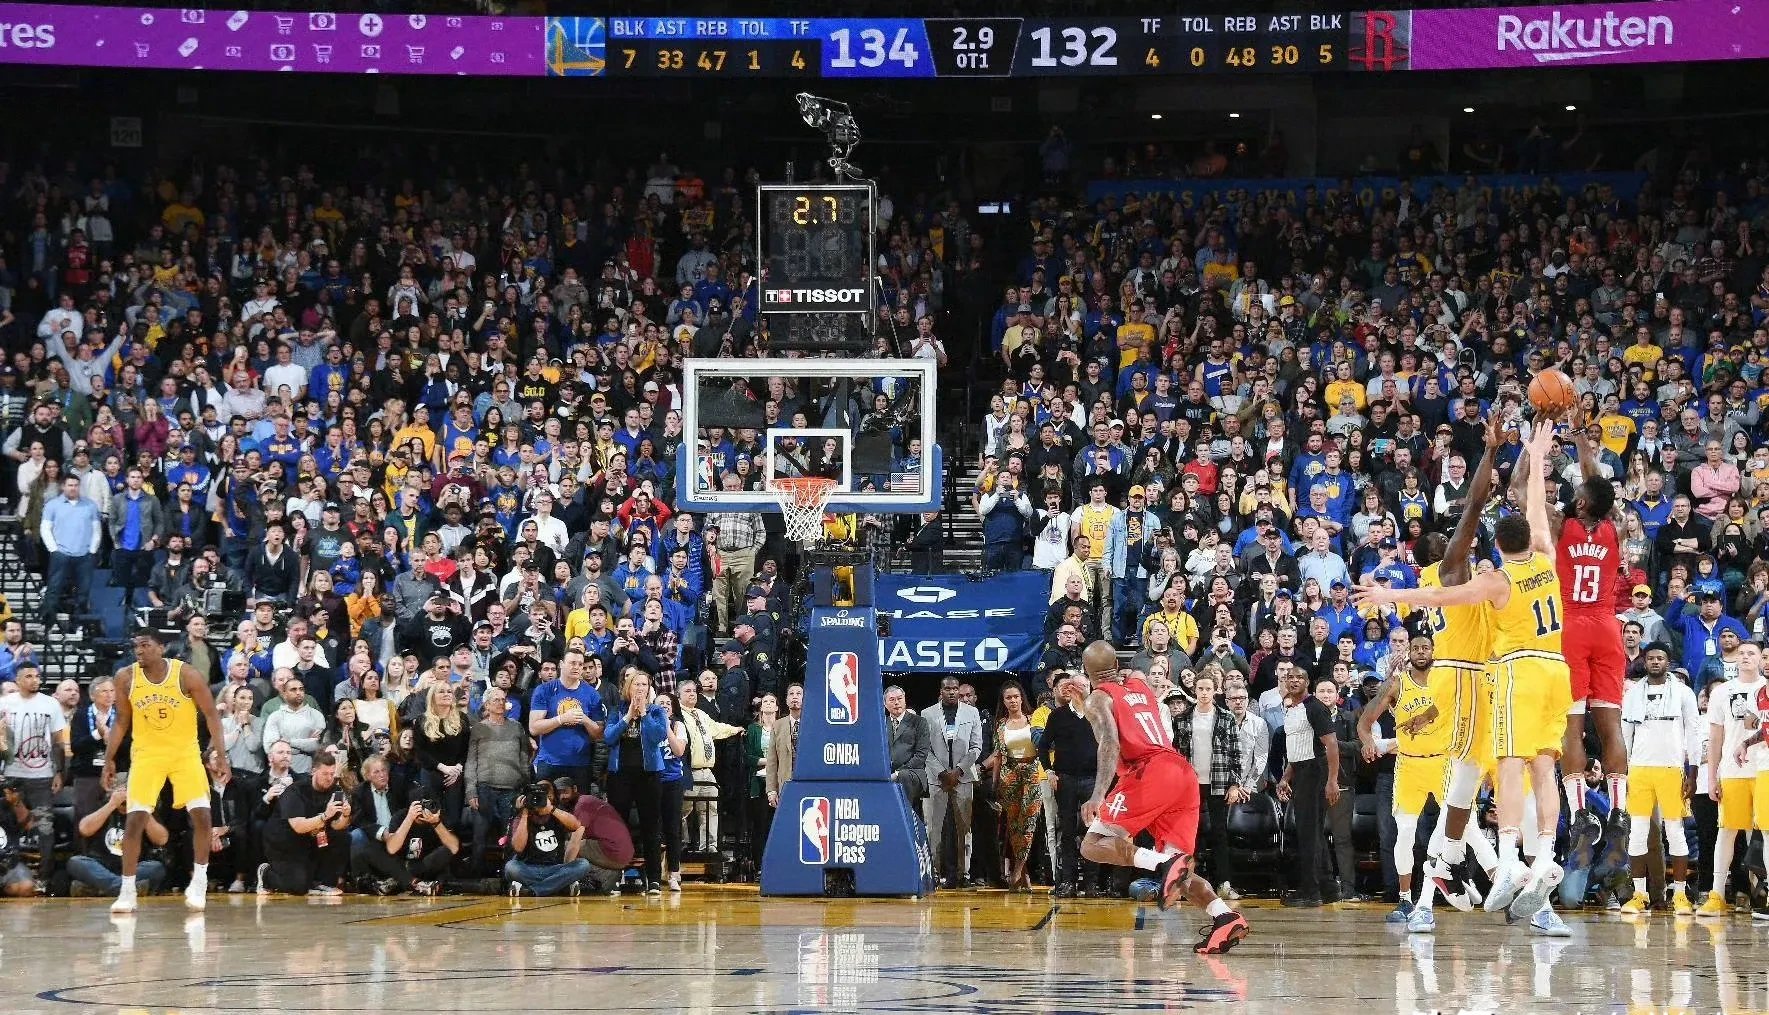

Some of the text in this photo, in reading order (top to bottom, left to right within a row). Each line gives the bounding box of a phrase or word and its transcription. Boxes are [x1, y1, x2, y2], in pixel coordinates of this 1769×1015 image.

[0, 23, 56, 48] res
[614, 21, 809, 35] BLK AST REB TOL TF
[1141, 14, 1342, 34] TF TOL REB AST BLK
[1497, 11, 1673, 51] Rakuten
[830, 28, 919, 68] 134
[952, 27, 994, 50] 2.9
[1030, 27, 1118, 67] 132
[623, 50, 806, 71] 7 33 47 1 4
[956, 53, 989, 69] OT1
[1145, 44, 1333, 67] 4 0 48 30 5
[793, 196, 837, 225] 2.7
[793, 289, 865, 303] TISSOT
[1568, 543, 1608, 561] HARDEN
[1572, 565, 1601, 602] 13
[820, 616, 865, 628] SPALDING
[875, 607, 1016, 619] HASE
[1532, 594, 1561, 637] 11
[878, 639, 967, 668] ASE
[159, 708, 168, 719] 5
[1134, 711, 1165, 746] 17
[823, 742, 860, 765] @NBA
[834, 798, 860, 820] NBA
[535, 834, 558, 847] TNT
[834, 819, 880, 846] League
[834, 841, 866, 864] Pass
